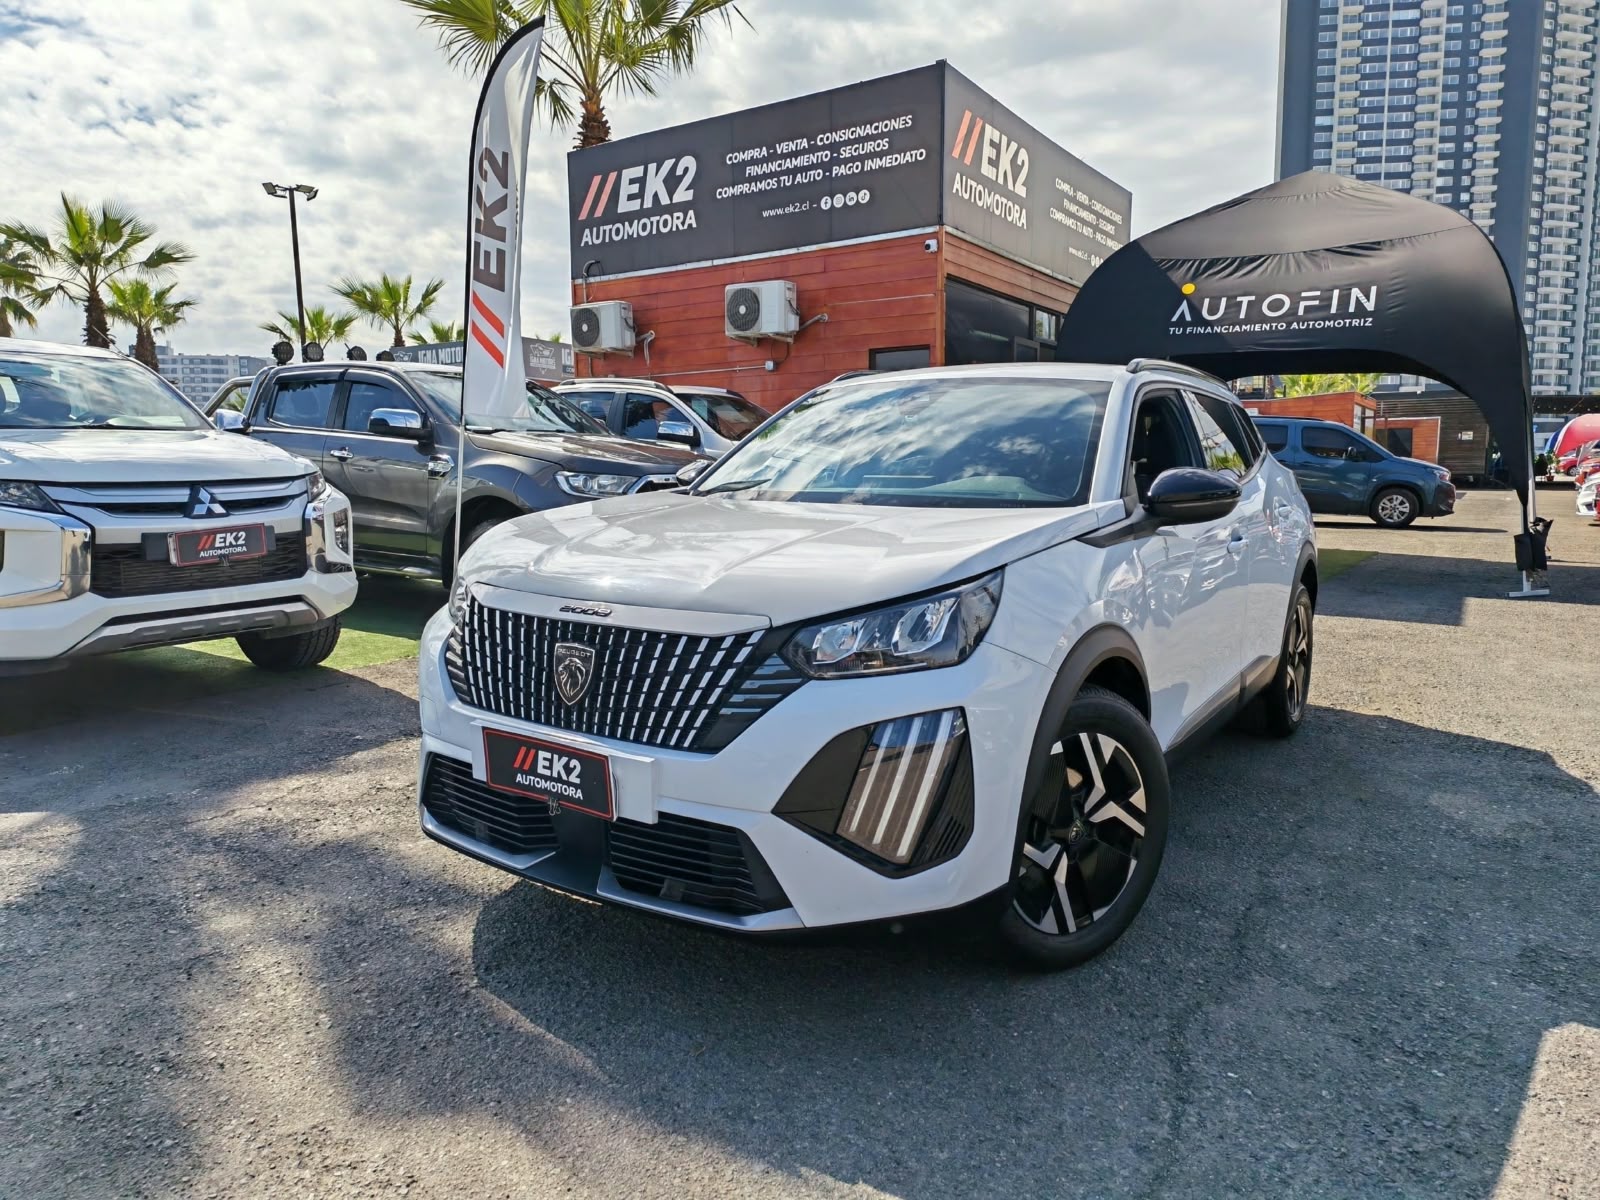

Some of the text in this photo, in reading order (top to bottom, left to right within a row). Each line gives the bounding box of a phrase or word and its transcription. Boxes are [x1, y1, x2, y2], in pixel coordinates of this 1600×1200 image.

[726, 146, 768, 165] COMPRA
[775, 138, 808, 154] VENTA
[816, 115, 913, 146] CONSIGNACIONES
[716, 177, 778, 199] COMPRAMOS
[779, 175, 793, 187] TU
[794, 169, 823, 185] AUTO
[832, 161, 861, 177] PAGO
[863, 148, 926, 172] INMEDIATO
[745, 150, 831, 177] FINANCIAMIENTO
[839, 138, 889, 159] SEGUROS
[762, 201, 810, 217] www.ek2.cl
[952, 172, 1027, 230] AUTOMOTORA
[580, 210, 697, 247] AUTOMOTORA
[1171, 284, 1377, 322] AUTOFIN
[1169, 317, 1374, 335] TU FINANCIAMIENTO AUTOMOTRIZ
[438, 346, 464, 364] MOTO
[200, 546, 247, 558] AUTOMOTORA
[558, 648, 592, 658] PEUGEOT
[515, 773, 583, 800] AUTOMOTORA
